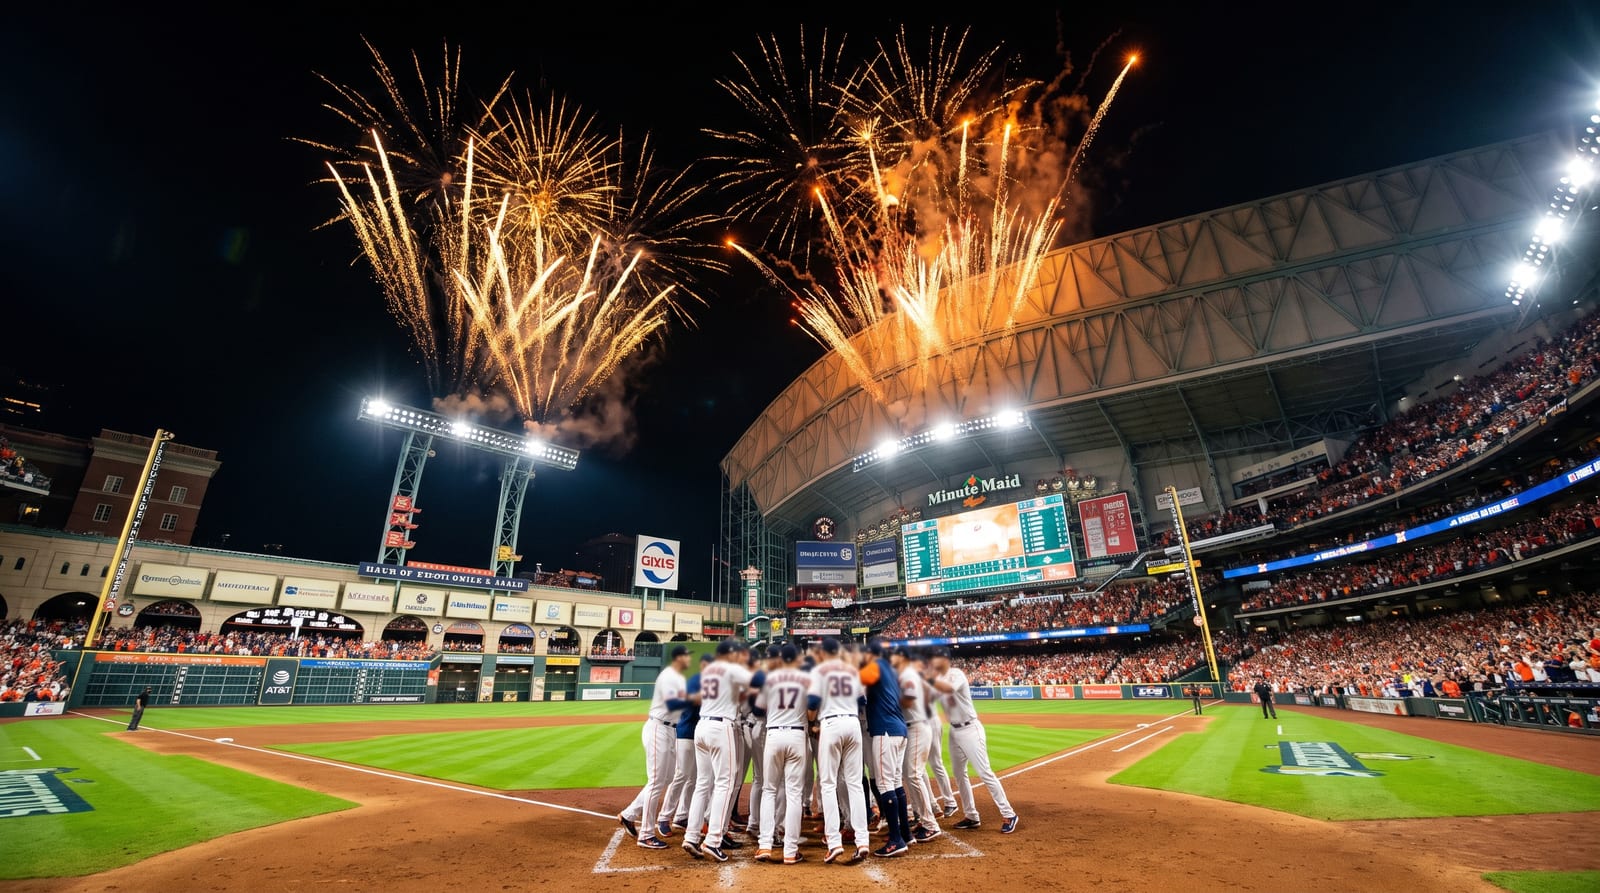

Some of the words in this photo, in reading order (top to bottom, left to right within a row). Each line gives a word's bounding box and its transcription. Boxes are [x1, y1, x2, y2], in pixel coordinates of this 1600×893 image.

[927, 484, 979, 506] Minute
[981, 474, 1022, 493] Maid
[400, 569, 413, 577] OF
[265, 686, 293, 694] AT&T
[828, 676, 853, 697] 36
[777, 687, 800, 710] 17
